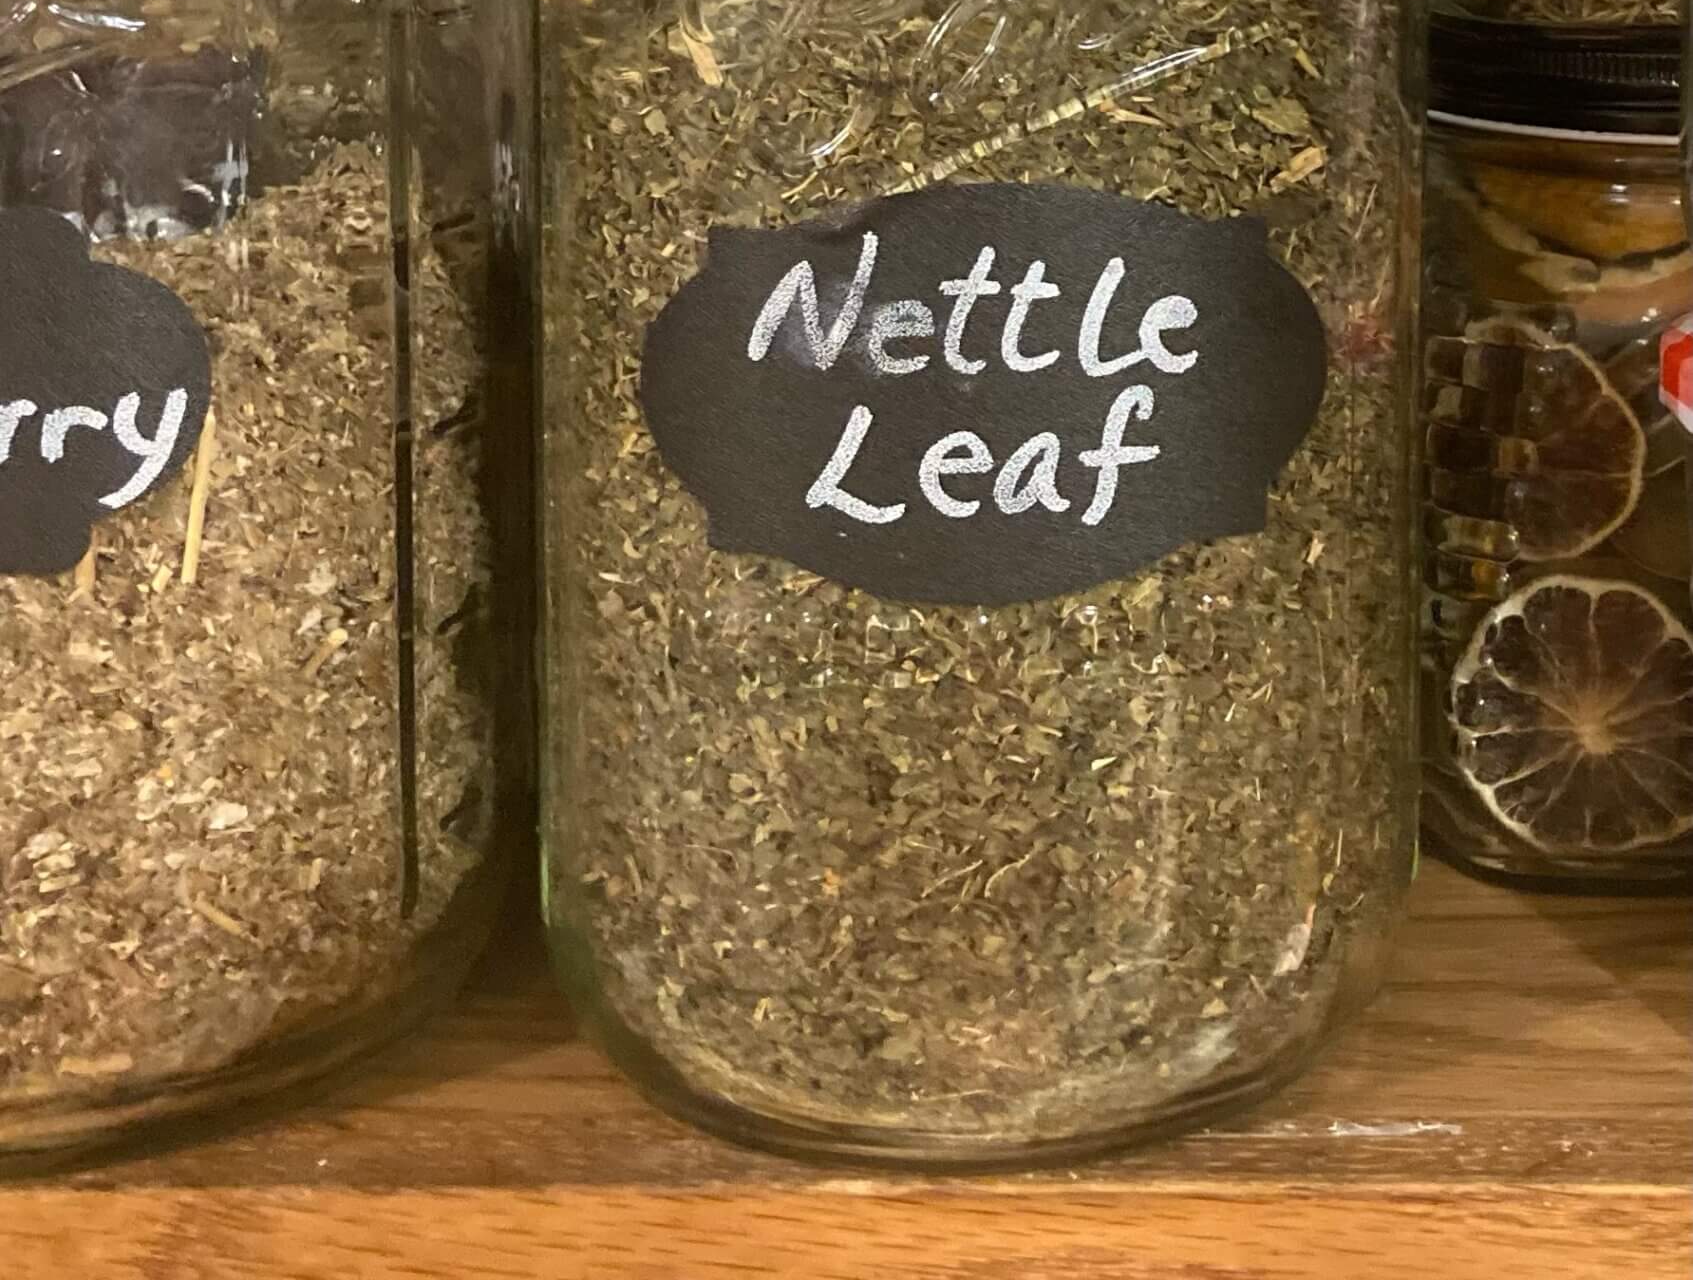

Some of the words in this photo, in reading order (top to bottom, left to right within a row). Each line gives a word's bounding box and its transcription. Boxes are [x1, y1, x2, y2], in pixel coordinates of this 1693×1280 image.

[747, 230, 1199, 378] Nettle
[0, 387, 188, 510] rry
[805, 383, 1161, 527] Leaf
